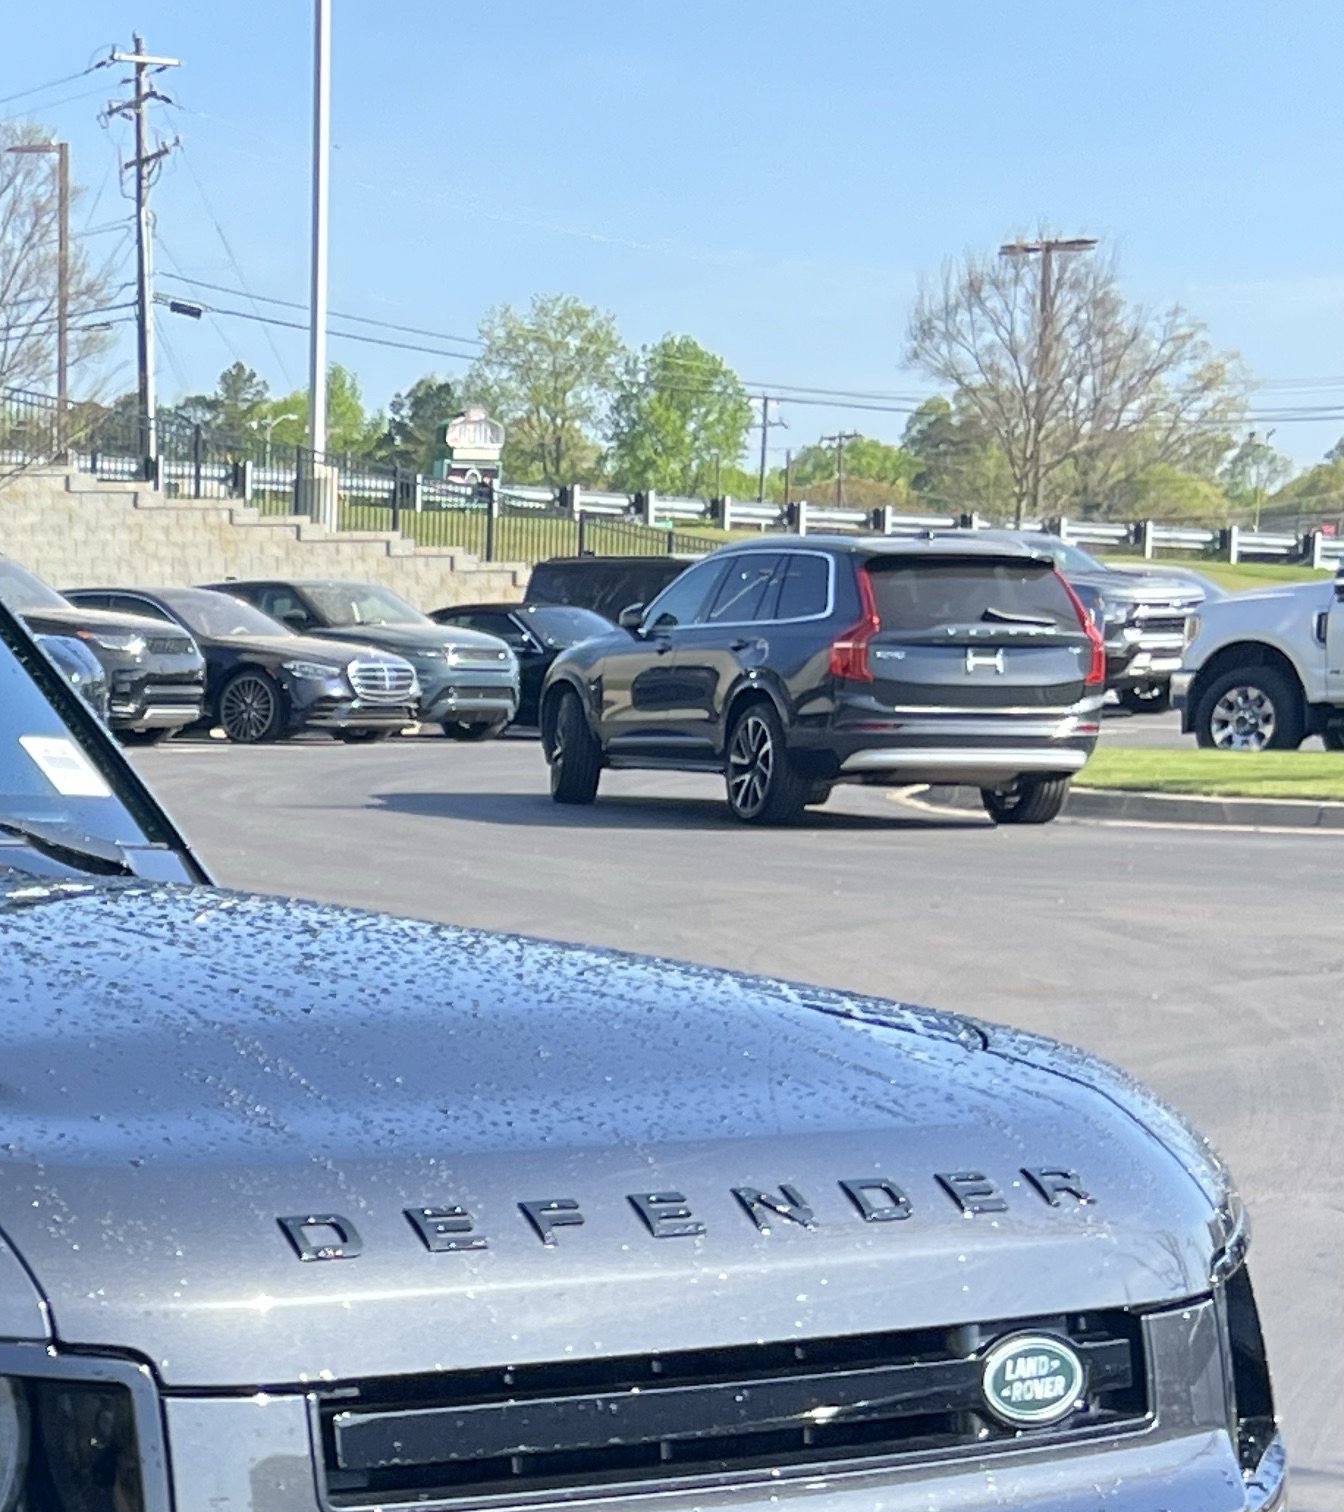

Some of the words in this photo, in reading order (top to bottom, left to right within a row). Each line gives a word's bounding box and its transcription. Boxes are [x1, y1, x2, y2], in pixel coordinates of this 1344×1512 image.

[274, 1165, 1098, 1264] DEFENDER
[1004, 1354, 1050, 1381] LAND
[1010, 1374, 1066, 1402] ROVER
